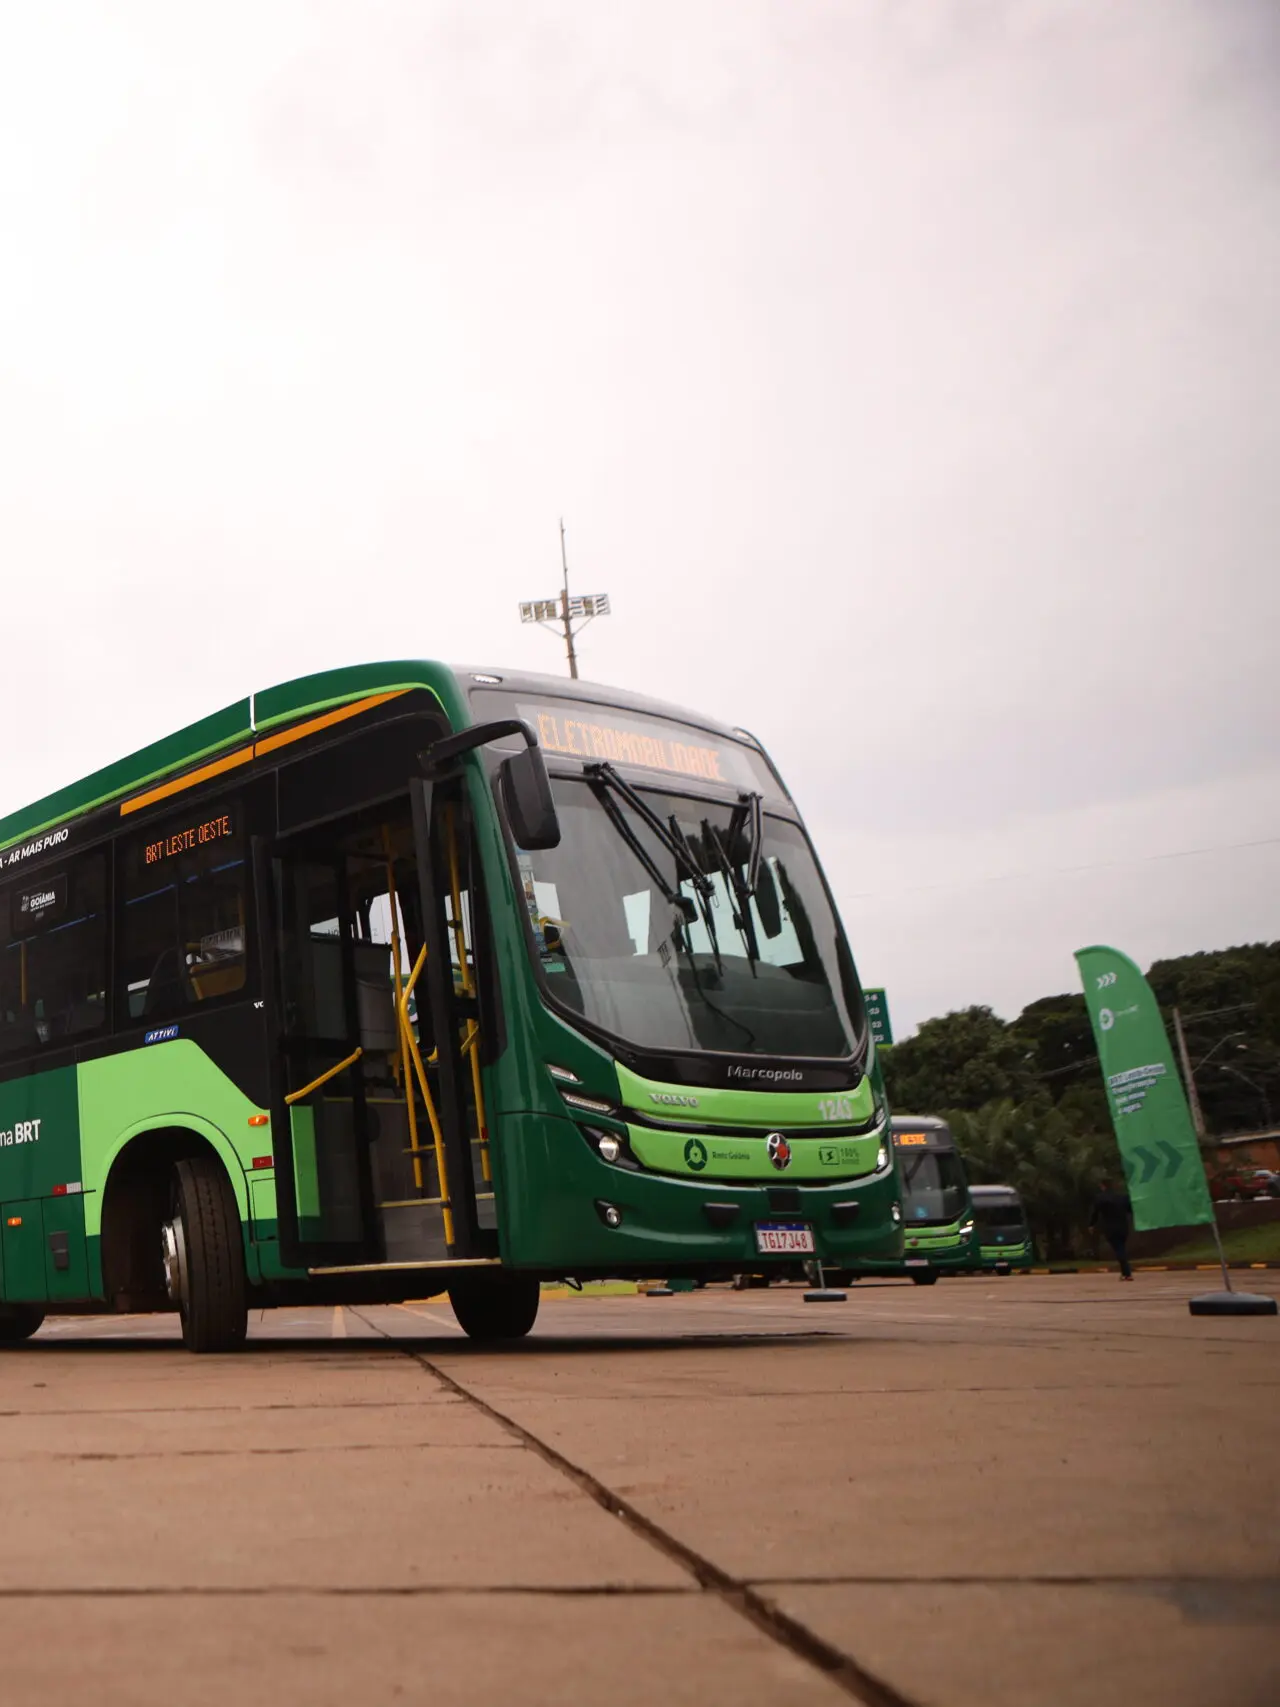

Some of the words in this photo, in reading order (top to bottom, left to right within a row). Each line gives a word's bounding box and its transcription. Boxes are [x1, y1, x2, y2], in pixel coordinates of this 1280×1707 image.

[8, 850, 21, 866] AR
[21, 839, 43, 860] MAIS
[43, 828, 69, 850] PURO
[145, 841, 164, 864] BRT
[166, 828, 196, 857] LESTE
[198, 815, 229, 843] OESTE
[148, 1027, 176, 1041] ATTIVI
[727, 1065, 803, 1082] Marcopolo
[649, 1093, 700, 1108] VOLVO
[14, 1119, 41, 1145] BRT
